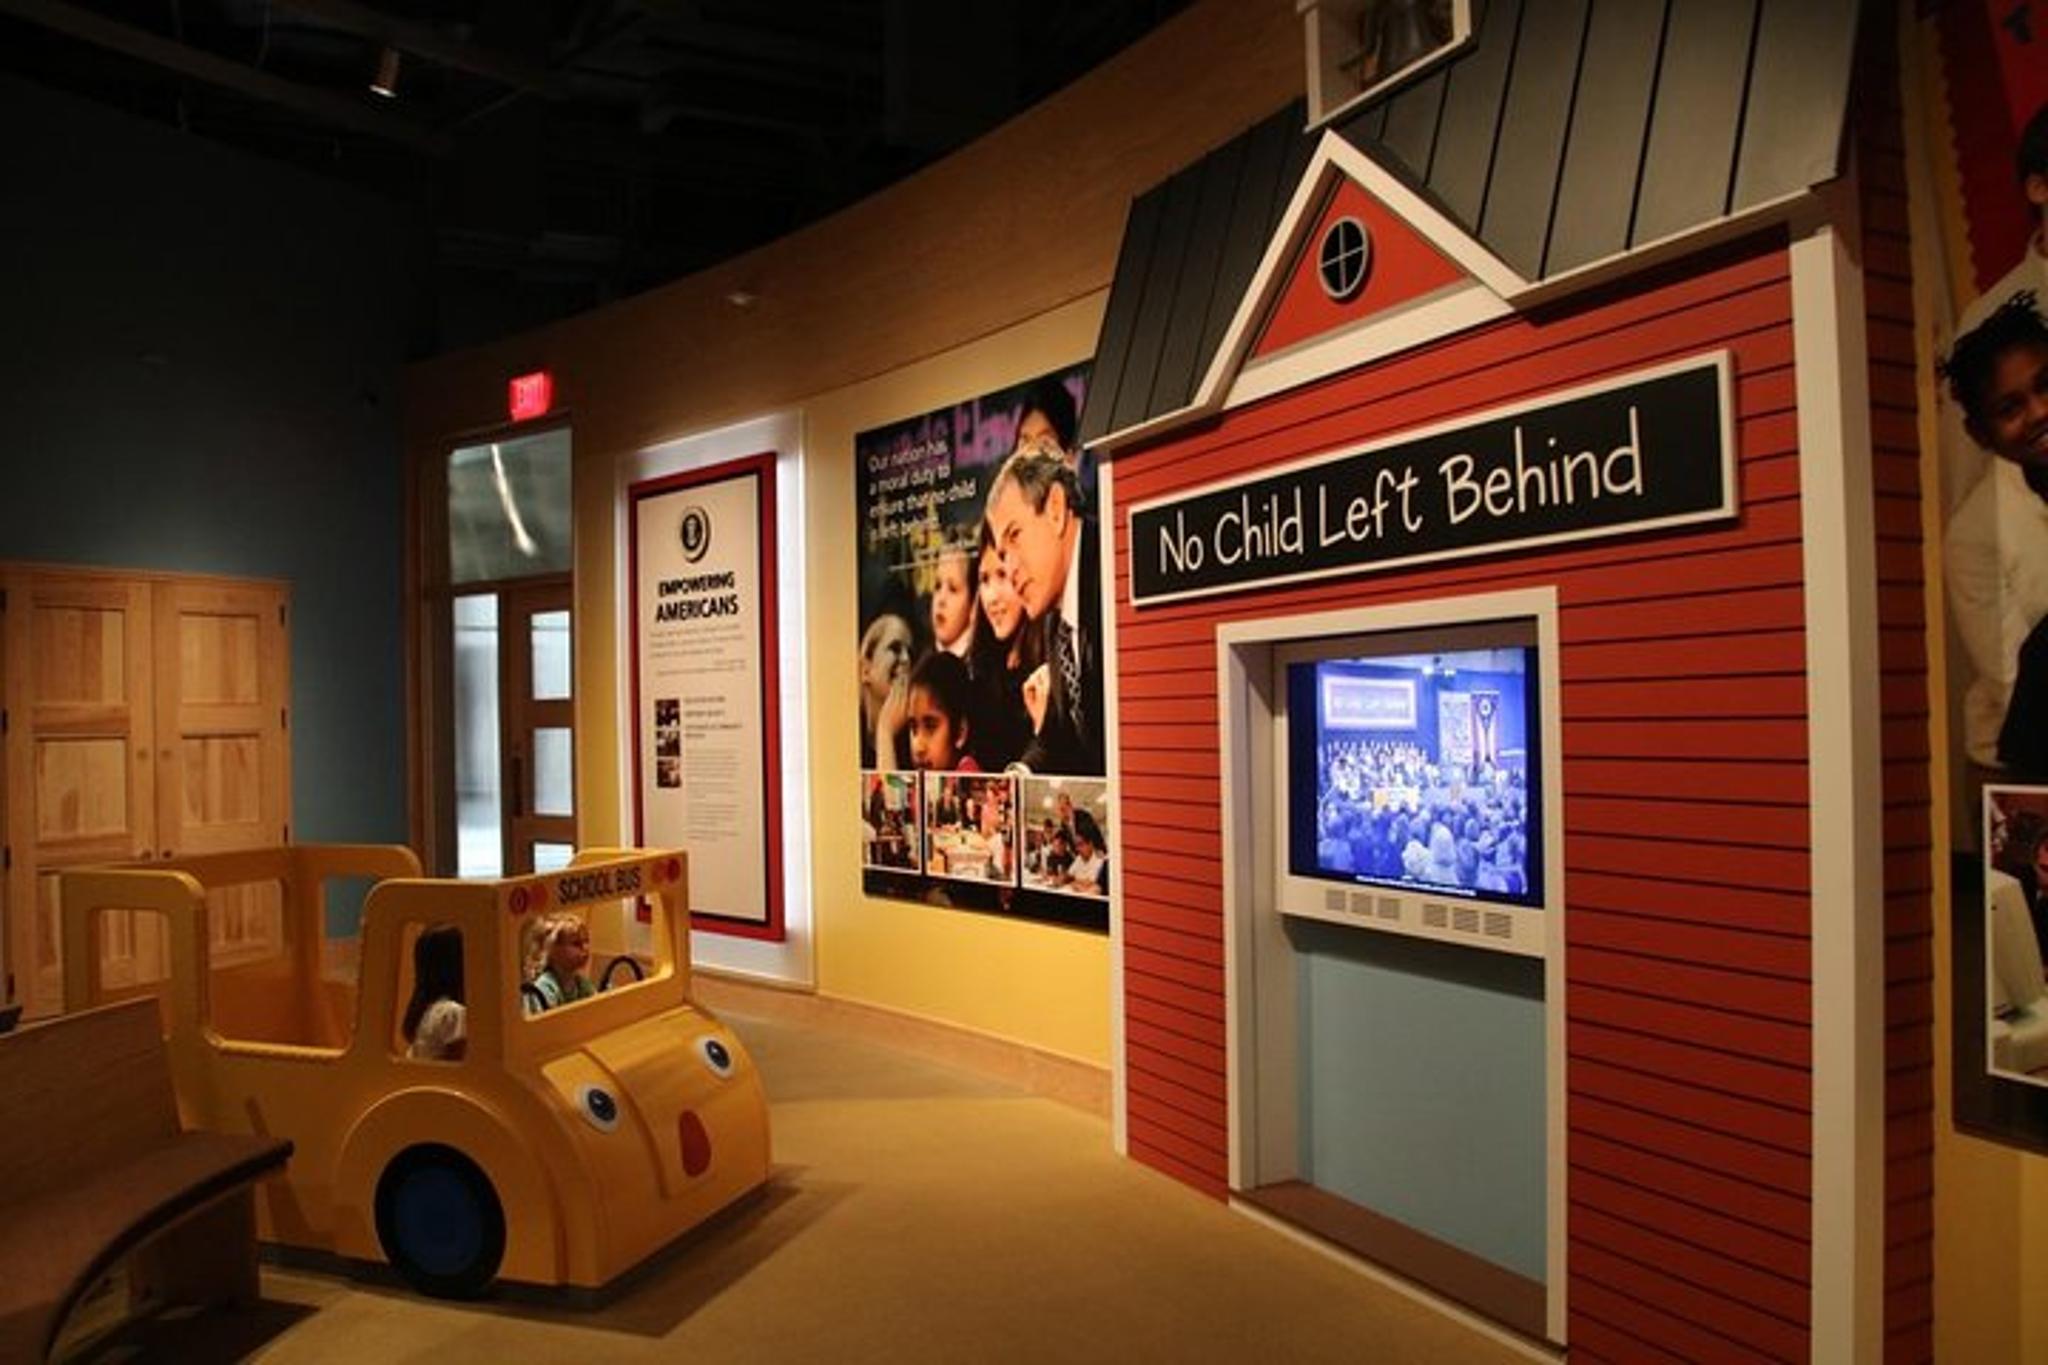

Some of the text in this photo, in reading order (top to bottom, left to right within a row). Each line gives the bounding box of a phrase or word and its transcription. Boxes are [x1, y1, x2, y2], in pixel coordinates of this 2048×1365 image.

[1159, 406, 1644, 574] No Child Left Behind
[658, 571, 736, 598] EMPOWERING
[655, 595, 740, 624] AMERICANS
[558, 865, 642, 905] SCHOOL BUS
